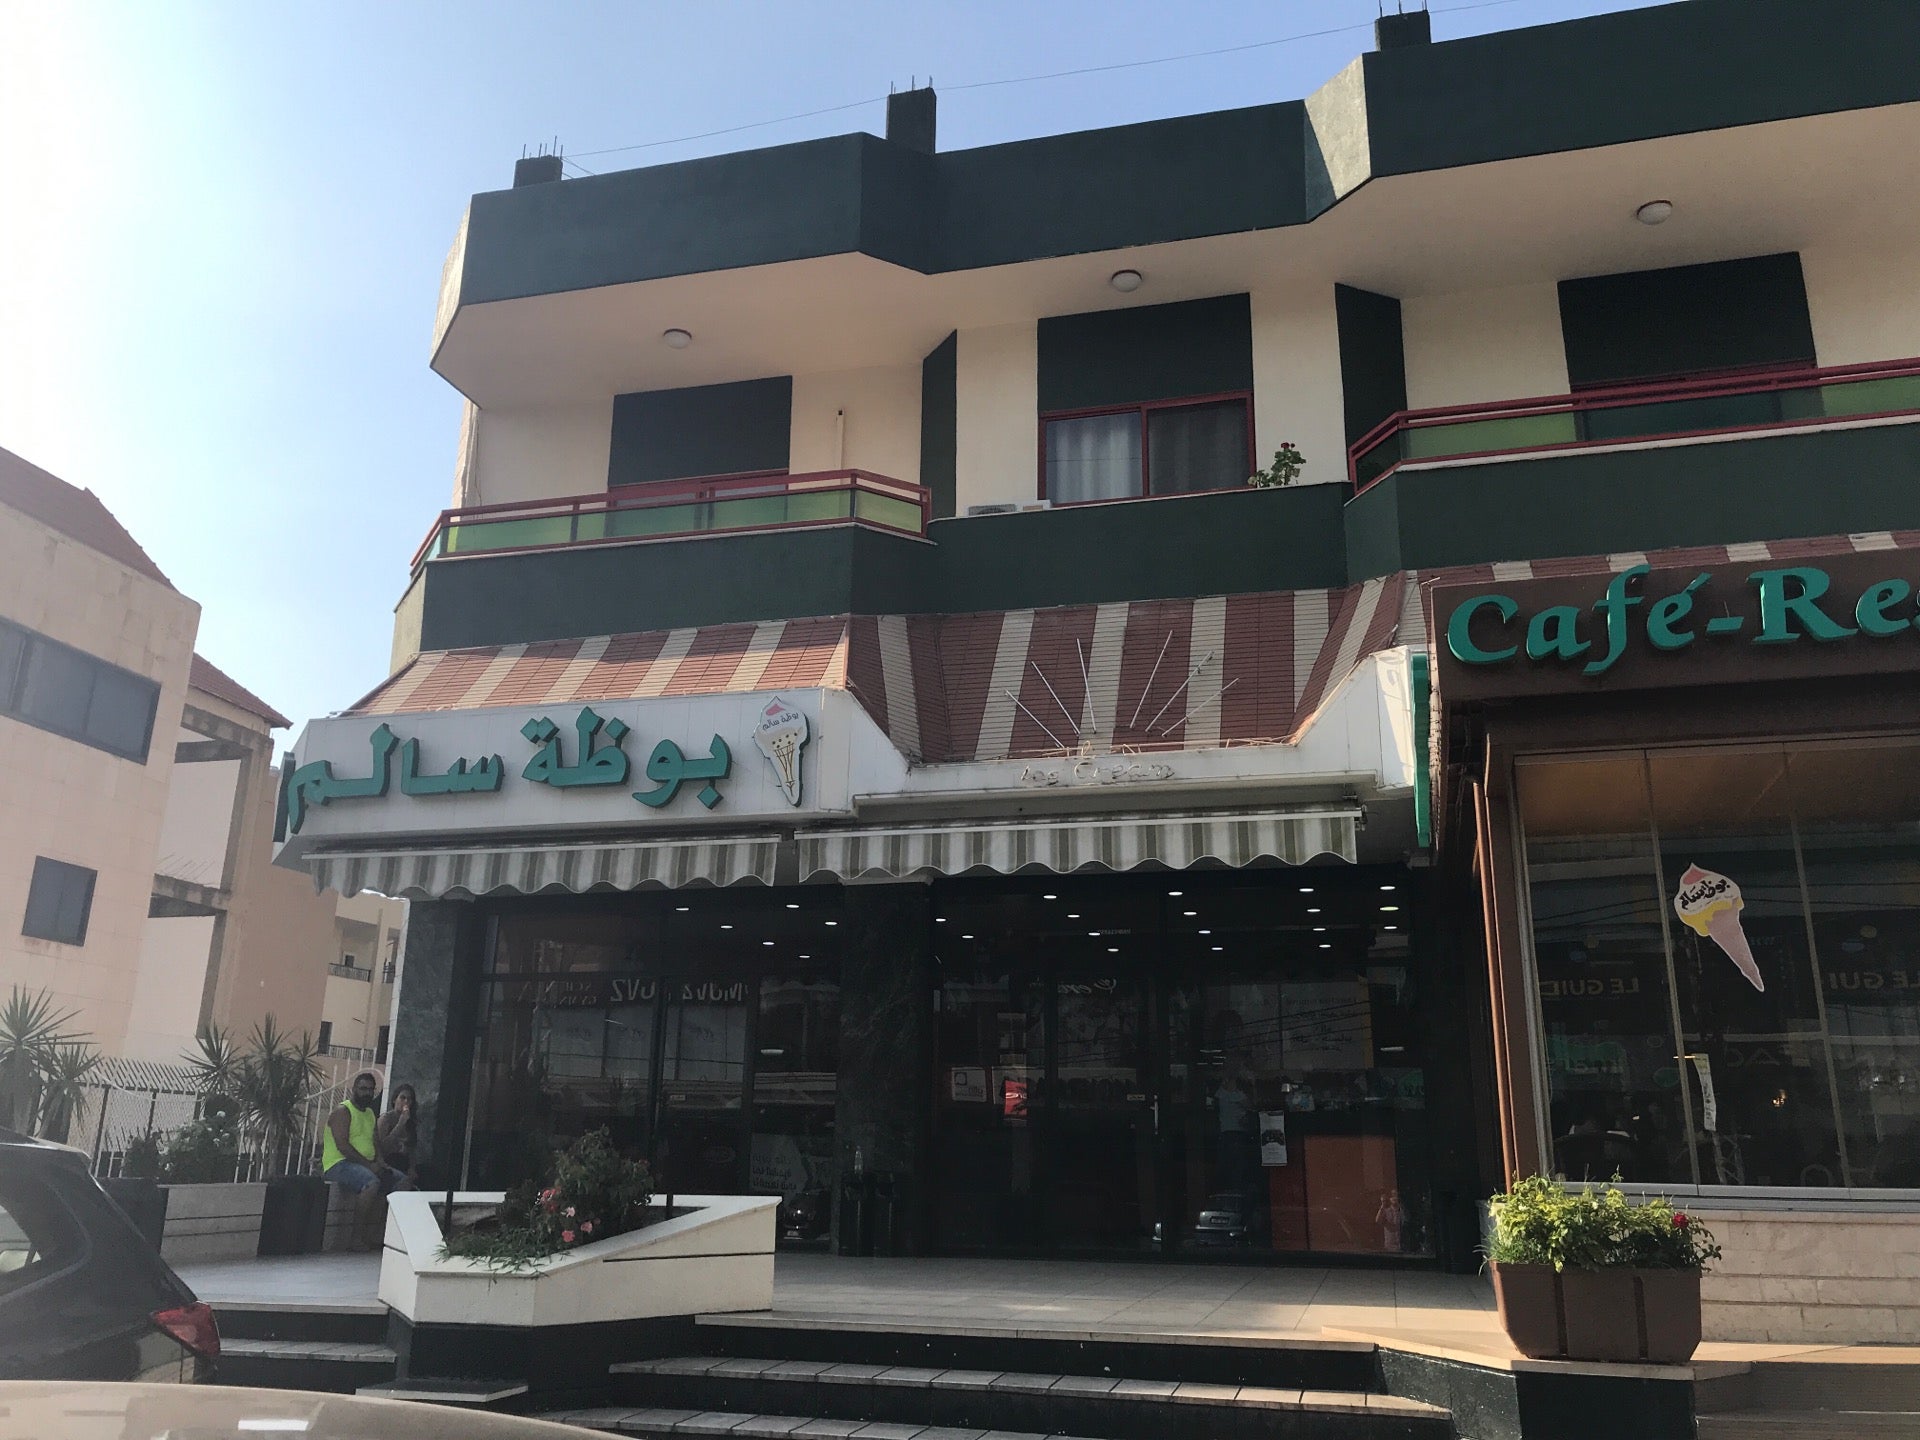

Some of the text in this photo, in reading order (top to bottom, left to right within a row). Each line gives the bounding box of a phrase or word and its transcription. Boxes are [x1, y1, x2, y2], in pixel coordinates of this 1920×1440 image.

[1447, 564, 1920, 676] Café-Re
[287, 705, 732, 835] بوظة سالم
